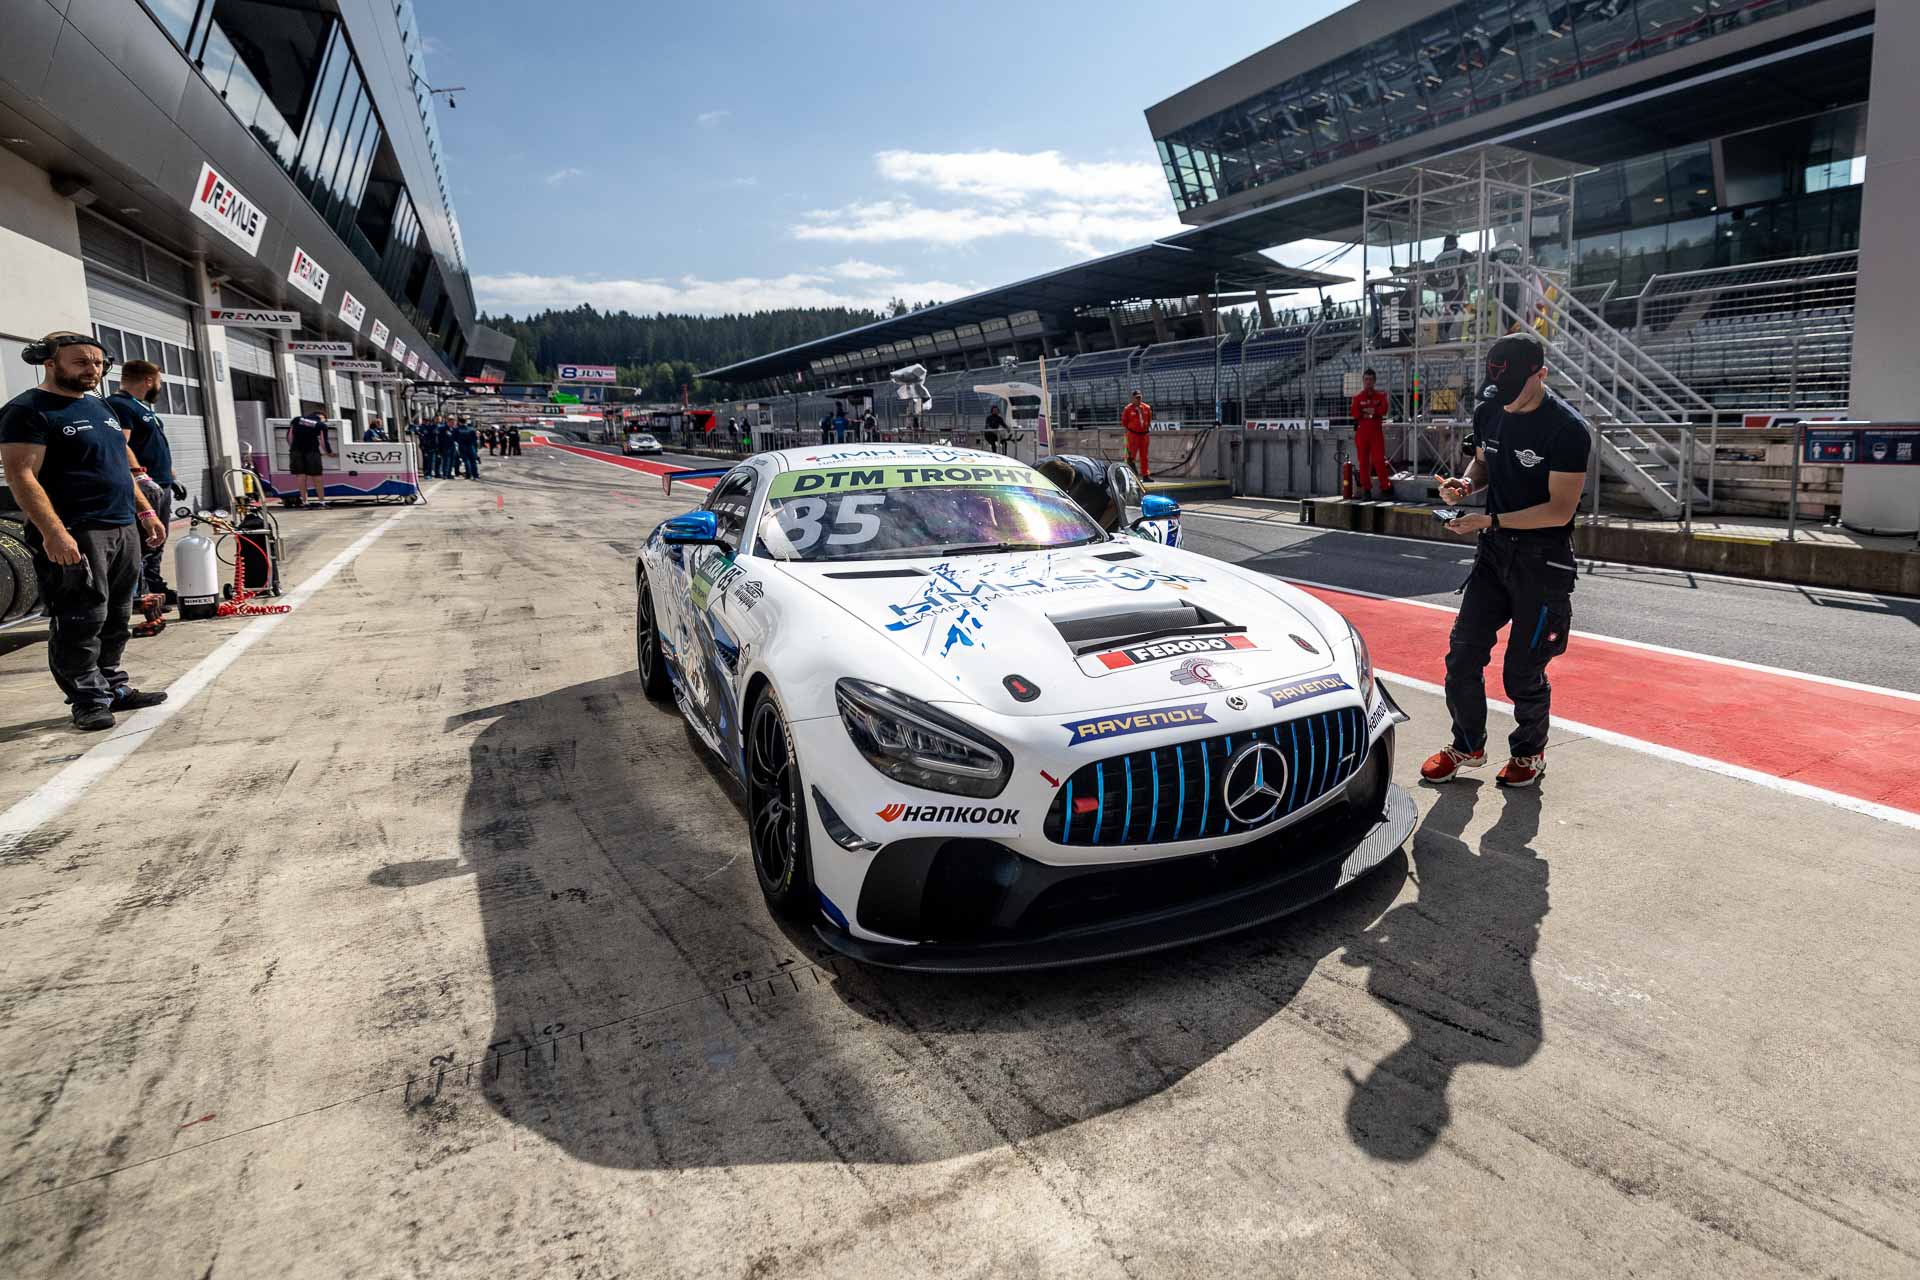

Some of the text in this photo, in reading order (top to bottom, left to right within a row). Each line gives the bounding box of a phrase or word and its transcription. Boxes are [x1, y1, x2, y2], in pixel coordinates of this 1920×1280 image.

[208, 181, 258, 238] REMUS
[220, 312, 293, 323] REMUS
[294, 343, 347, 351] REMUS
[364, 451, 402, 462] GVR
[793, 468, 1034, 493] DTM TROPHY
[782, 494, 886, 550] 85
[717, 568, 743, 592] 85
[1132, 637, 1226, 661] FERODO
[1271, 675, 1346, 702] RAVENOL
[1077, 707, 1203, 738] RAVENOL
